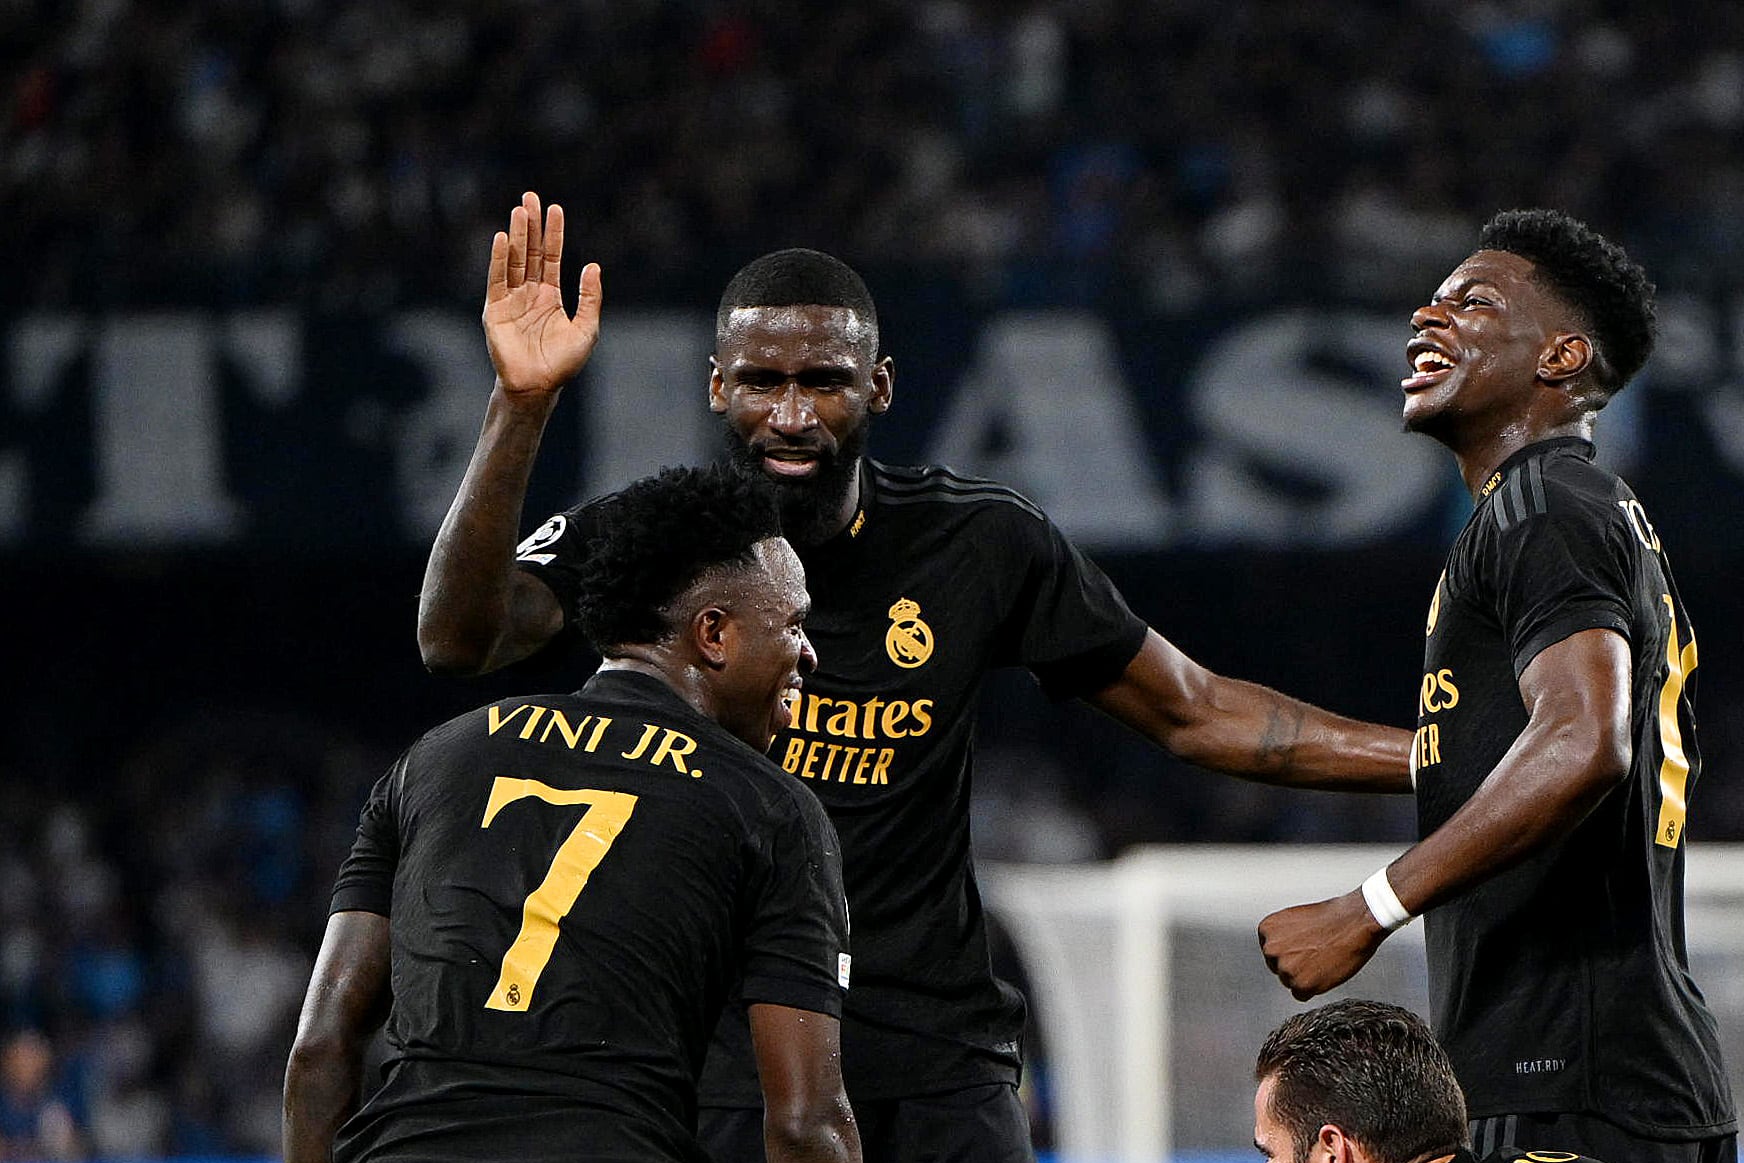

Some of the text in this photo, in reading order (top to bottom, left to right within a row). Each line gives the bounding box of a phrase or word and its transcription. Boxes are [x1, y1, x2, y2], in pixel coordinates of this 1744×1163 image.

[488, 704, 704, 779] VINI JR.
[781, 737, 895, 785] BETTER
[1658, 593, 1698, 847] 1
[481, 776, 639, 1012] 7
